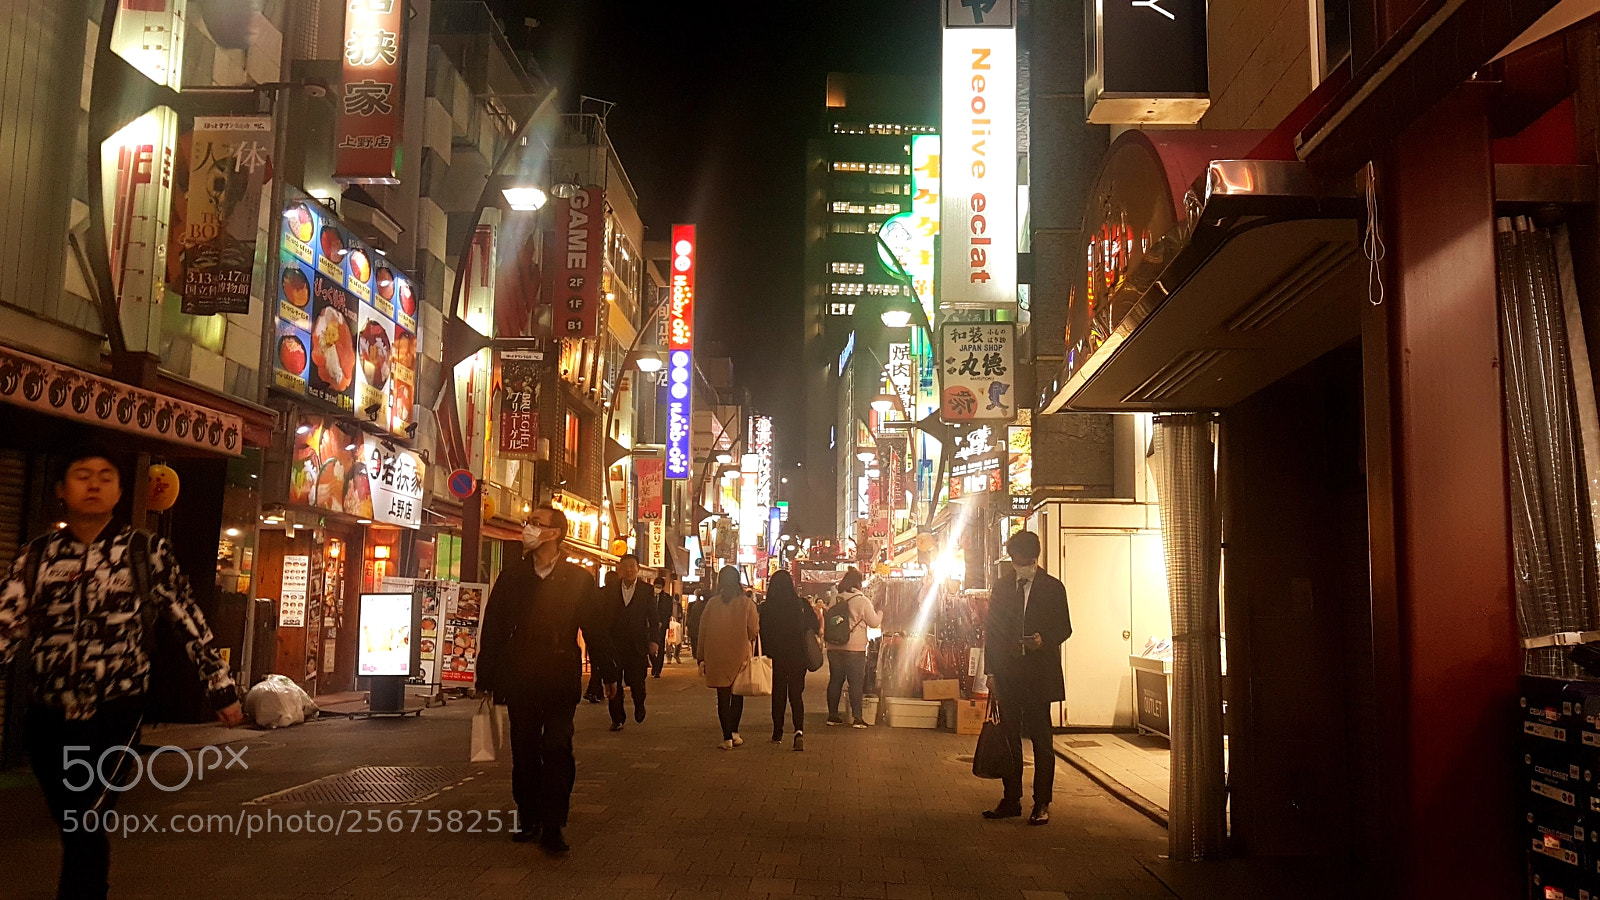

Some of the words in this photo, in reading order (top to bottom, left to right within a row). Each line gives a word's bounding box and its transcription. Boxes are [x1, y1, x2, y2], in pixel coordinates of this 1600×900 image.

[971, 48, 991, 178] Neolive
[339, 135, 391, 148] 上野店
[567, 188, 590, 269] GAME
[970, 192, 991, 283] eclat
[569, 278, 583, 287] 2F
[569, 299, 582, 308] 1F
[567, 320, 582, 330] B1
[950, 326, 984, 343] 和装
[959, 344, 982, 352] JAPAN
[983, 344, 1003, 352] SHOP
[893, 345, 910, 377] 焼肉
[958, 351, 1007, 377] 丸徳
[508, 392, 522, 450] ブリューゲル
[520, 393, 531, 448] BRUEGHEL
[388, 497, 412, 520] 上野店
